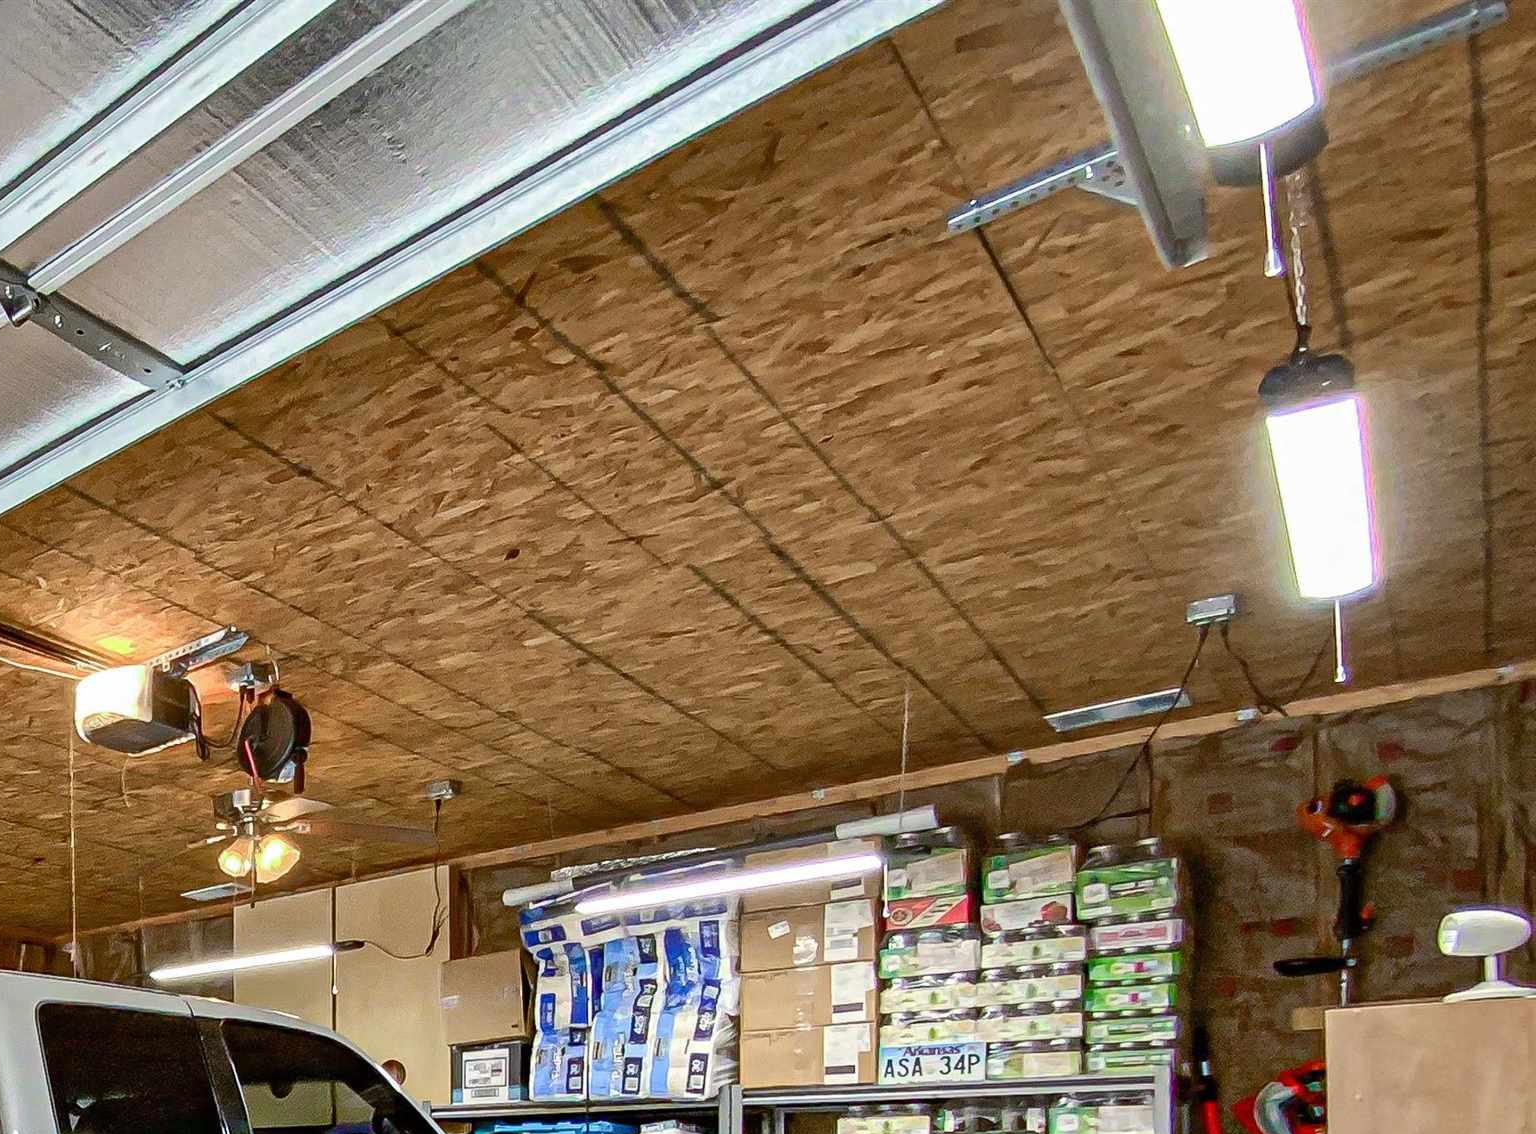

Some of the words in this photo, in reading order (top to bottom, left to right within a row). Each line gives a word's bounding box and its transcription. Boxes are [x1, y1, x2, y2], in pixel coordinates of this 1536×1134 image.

[903, 1045, 962, 1057] Arkansas
[626, 1063, 637, 1075] 30
[691, 1059, 701, 1073] 30
[884, 1057, 923, 1078] ASA
[939, 1053, 981, 1075] 34P
